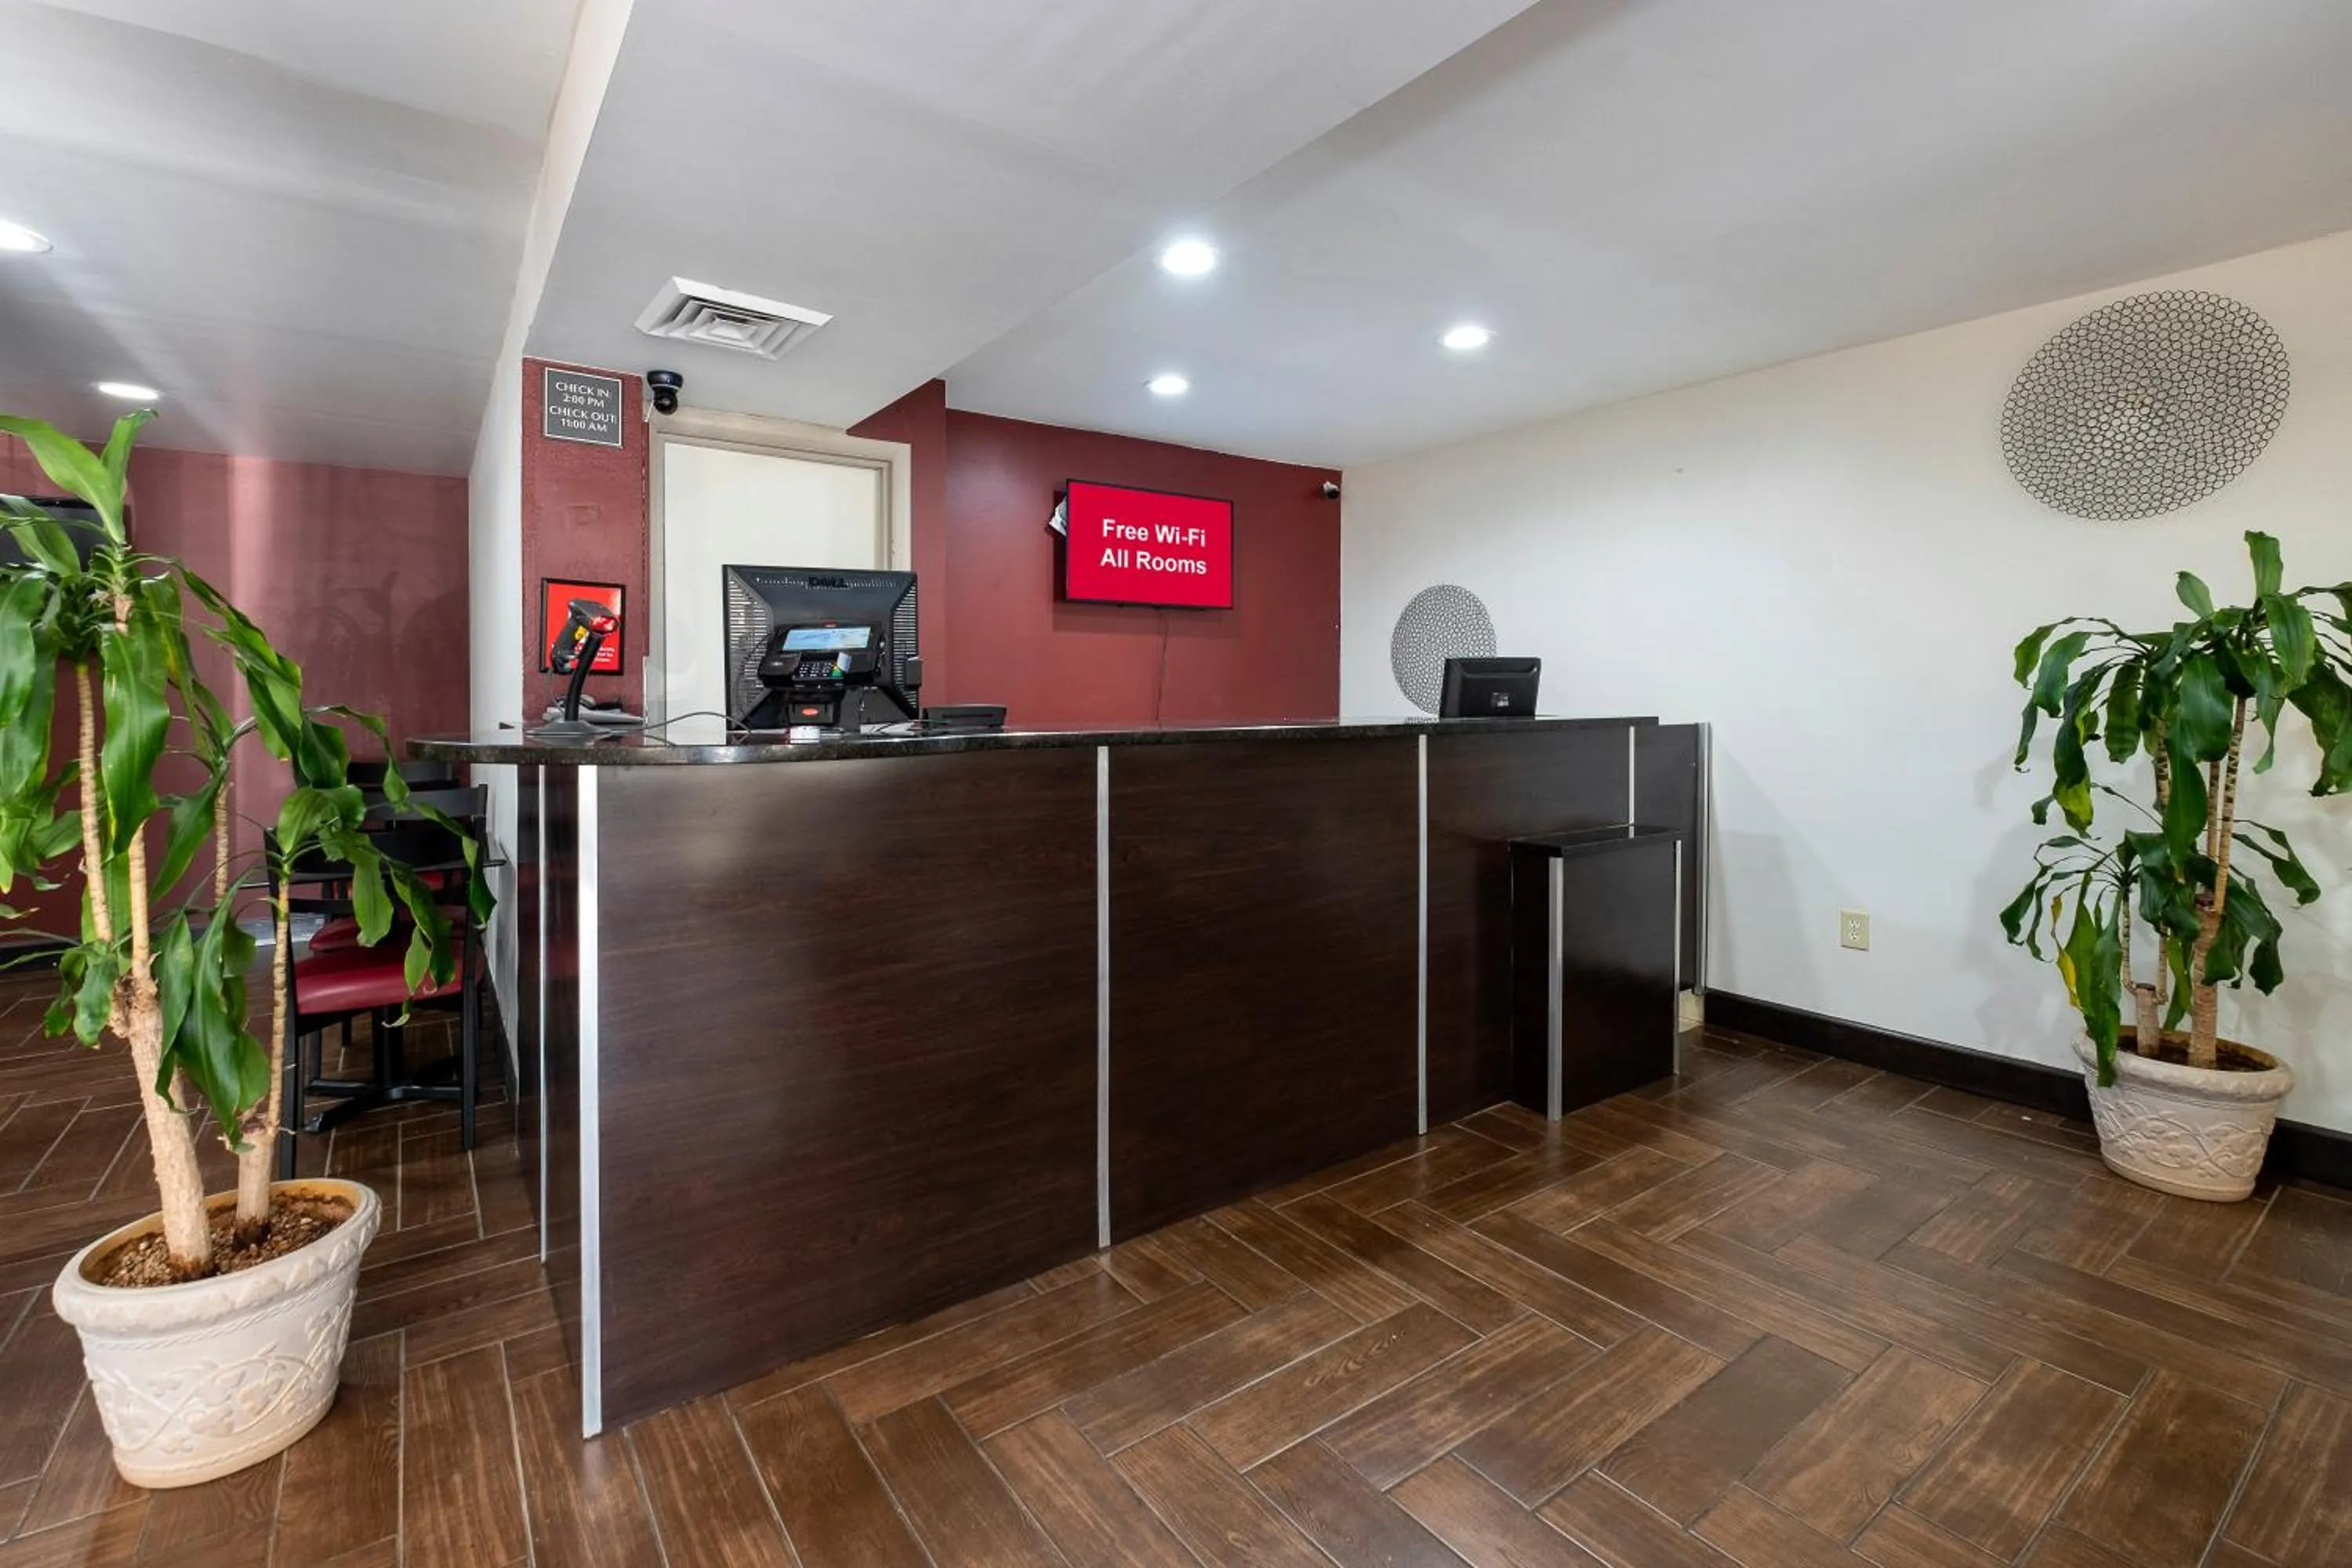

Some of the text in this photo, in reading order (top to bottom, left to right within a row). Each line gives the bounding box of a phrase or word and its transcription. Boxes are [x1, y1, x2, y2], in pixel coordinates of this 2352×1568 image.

[555, 382, 594, 396] CHECK
[563, 393, 604, 408] 2:00 PM
[550, 405, 588, 419] CHECK
[561, 418, 607, 433] 11:00 AM
[1102, 518, 1206, 547] Free Wi-Fi
[1100, 548, 1207, 575] All Rooms
